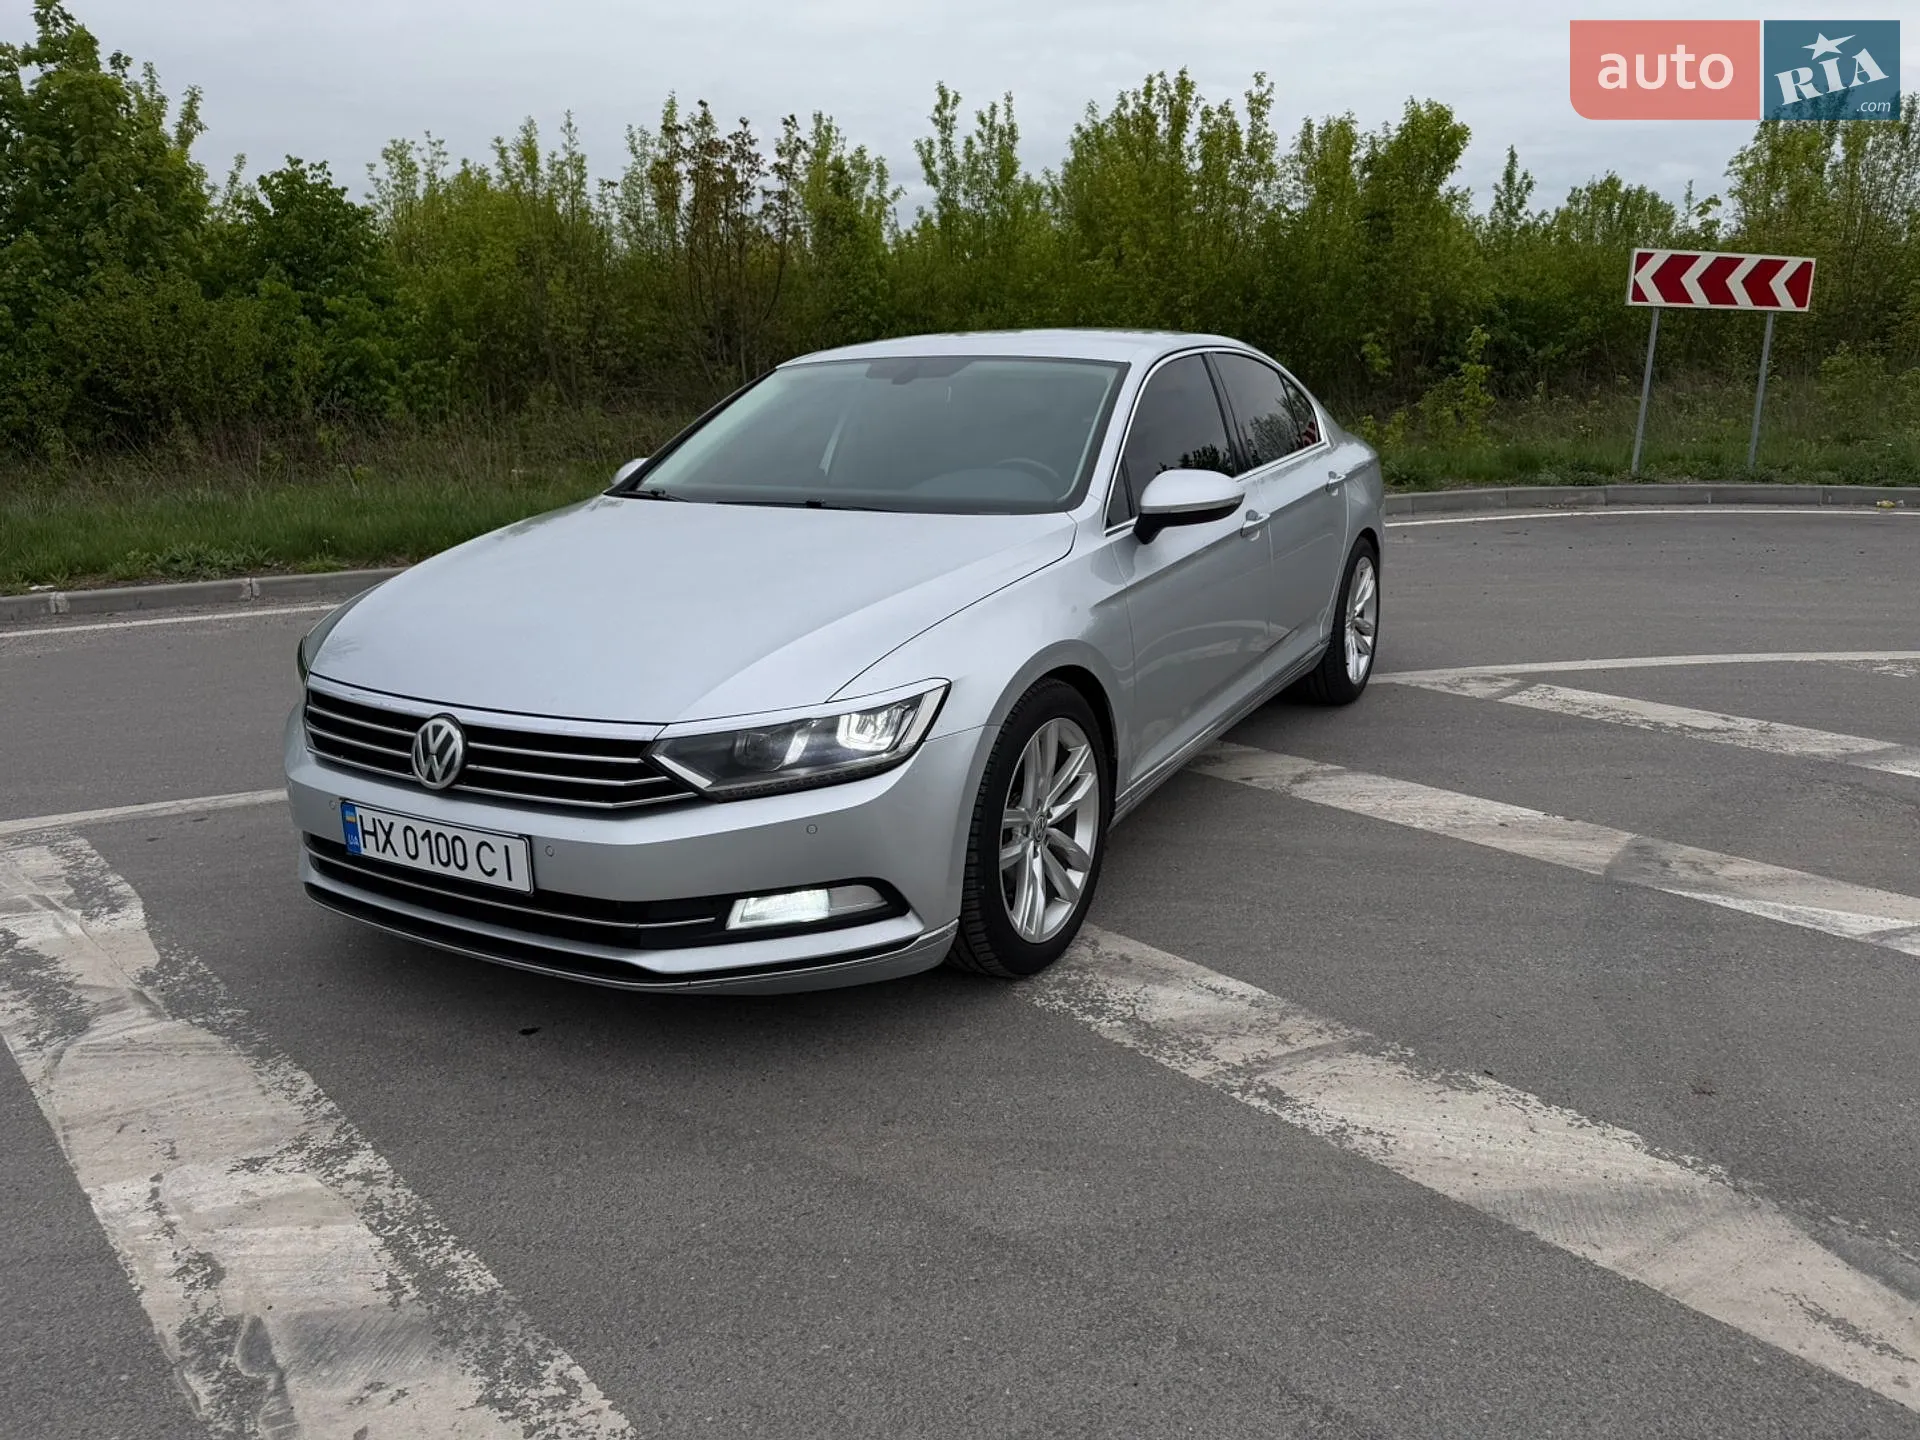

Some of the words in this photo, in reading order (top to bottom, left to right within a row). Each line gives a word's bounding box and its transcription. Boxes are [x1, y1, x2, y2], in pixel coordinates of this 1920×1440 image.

[359, 814, 398, 857] HX
[403, 825, 468, 871] 0100
[476, 840, 513, 882] CI
